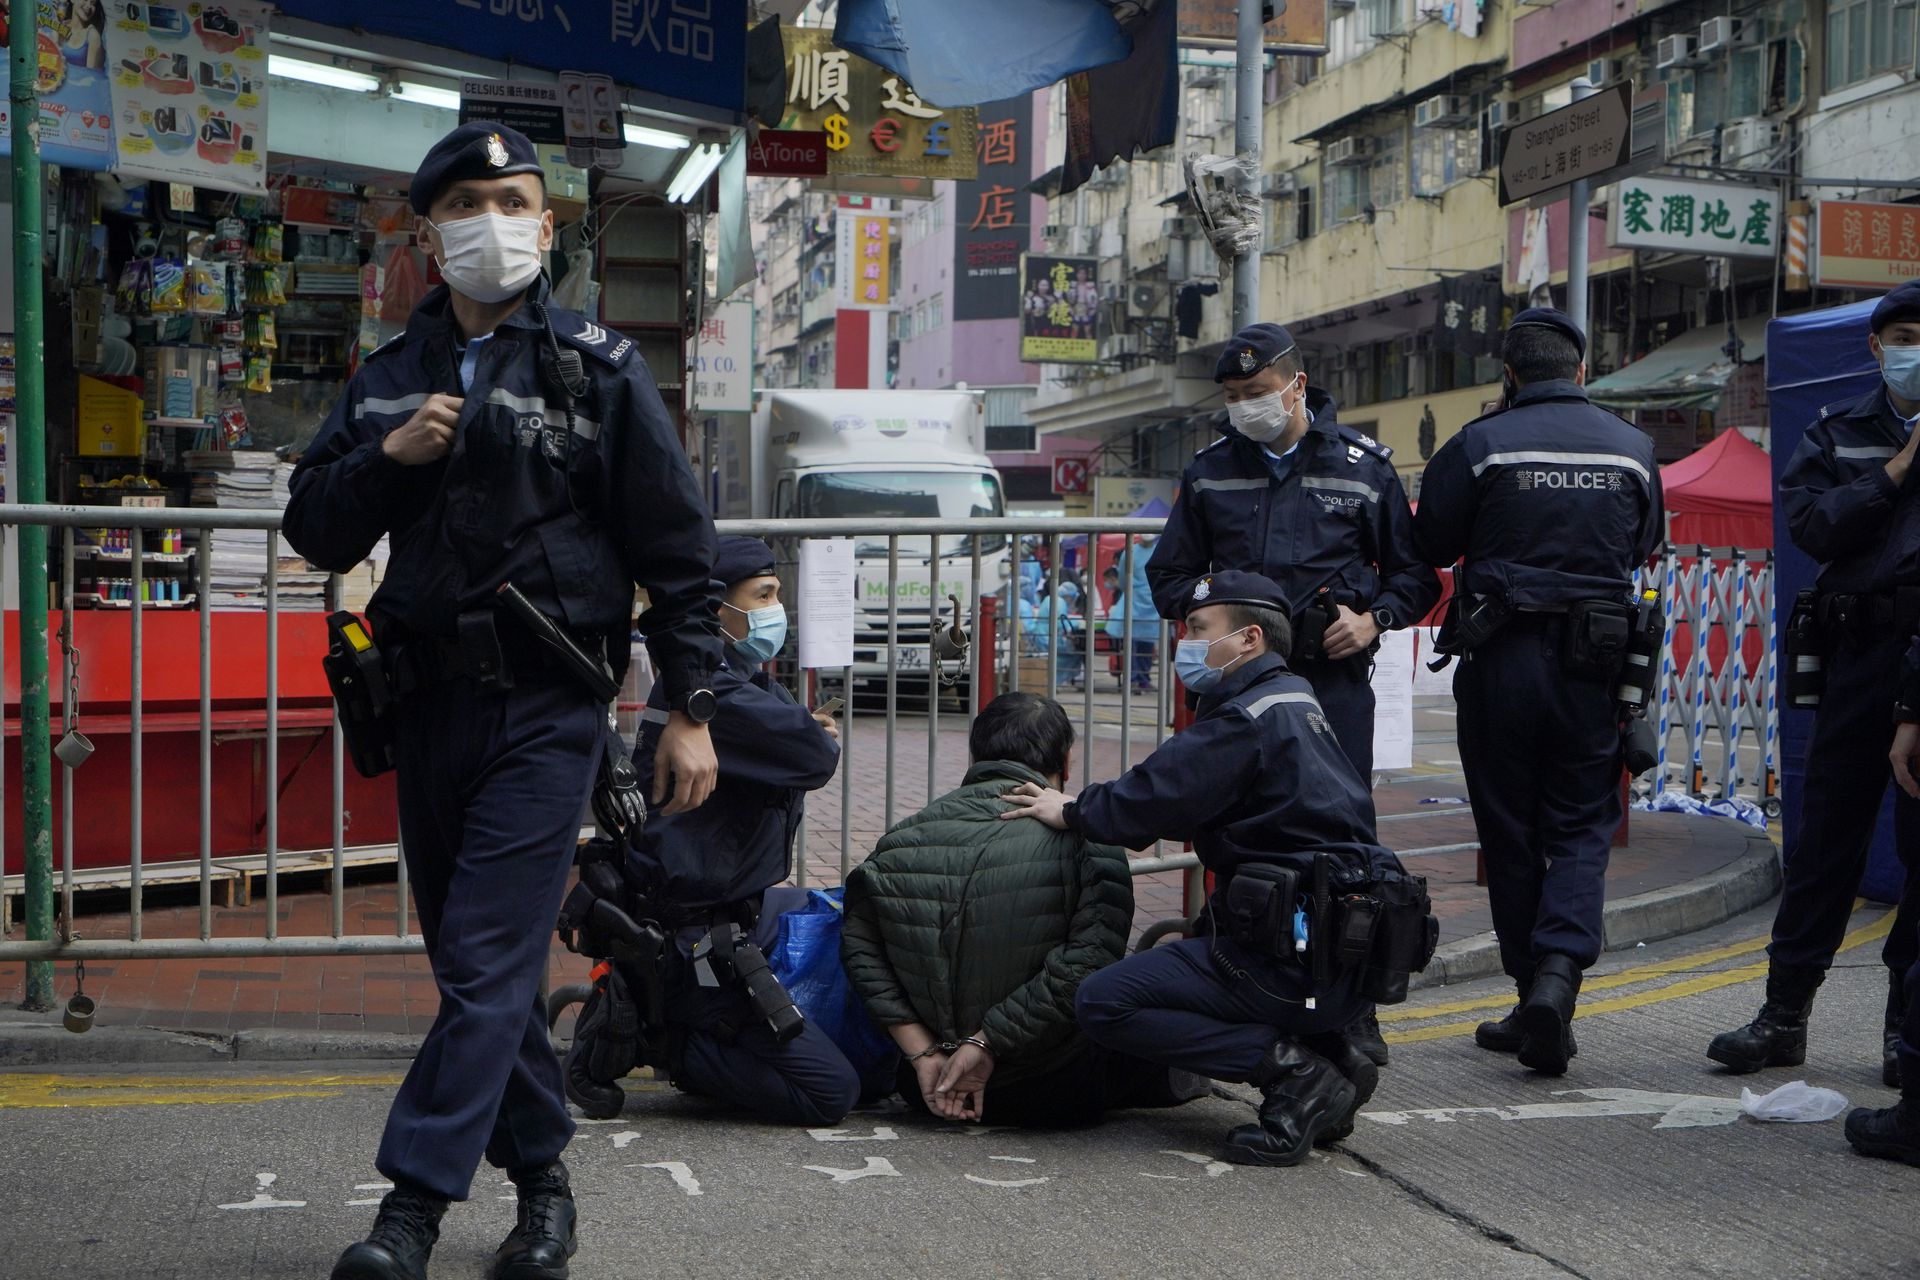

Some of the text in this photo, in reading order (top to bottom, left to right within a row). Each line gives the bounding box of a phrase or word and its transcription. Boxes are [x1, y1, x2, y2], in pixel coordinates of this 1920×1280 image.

[464, 82, 505, 96] CELSIUS
[1526, 105, 1601, 150] Shanghai Street
[747, 142, 817, 163] arTone
[1541, 145, 1582, 180] 上海街
[1622, 187, 1772, 246] 家潤地產
[609, 339, 632, 361] 58533
[713, 356, 737, 372] CO.
[517, 415, 567, 447] POCE
[1534, 471, 1606, 489] POLICE
[1324, 495, 1362, 508] POLICE
[866, 581, 947, 597] MdFot
